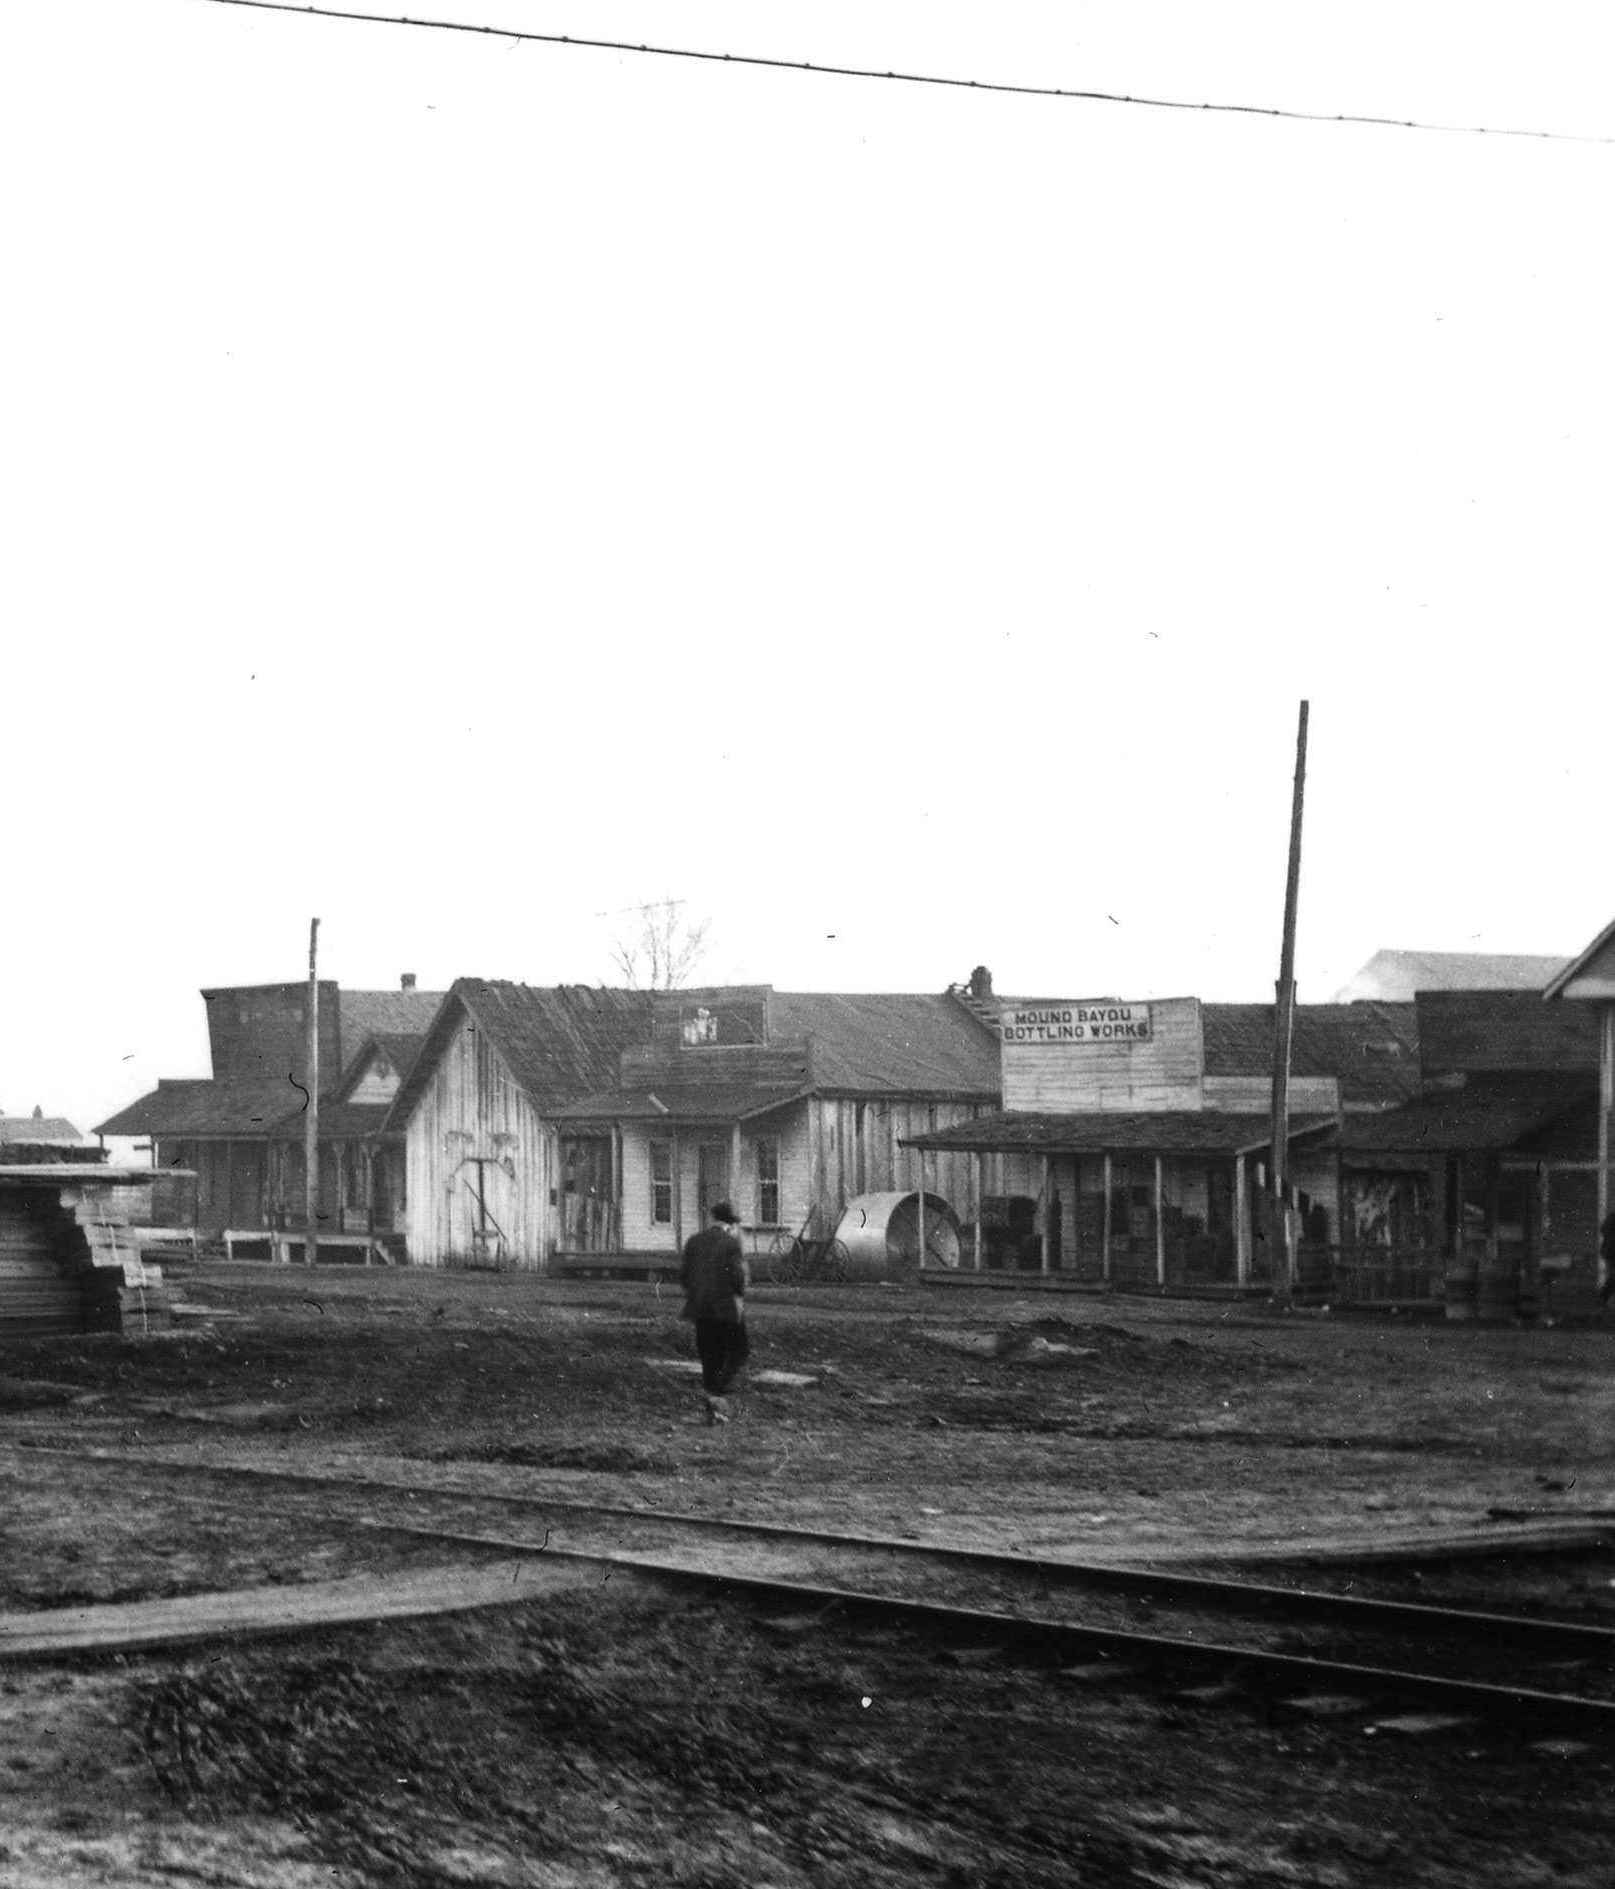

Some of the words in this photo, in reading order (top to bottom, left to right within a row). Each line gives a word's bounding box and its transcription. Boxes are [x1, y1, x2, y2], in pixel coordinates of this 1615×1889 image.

[1015, 1011, 1072, 1024] MOUND
[1078, 1009, 1131, 1022] BAYOU
[1004, 1025, 1084, 1039] BOTTLING
[1090, 1022, 1148, 1037] WORKS
